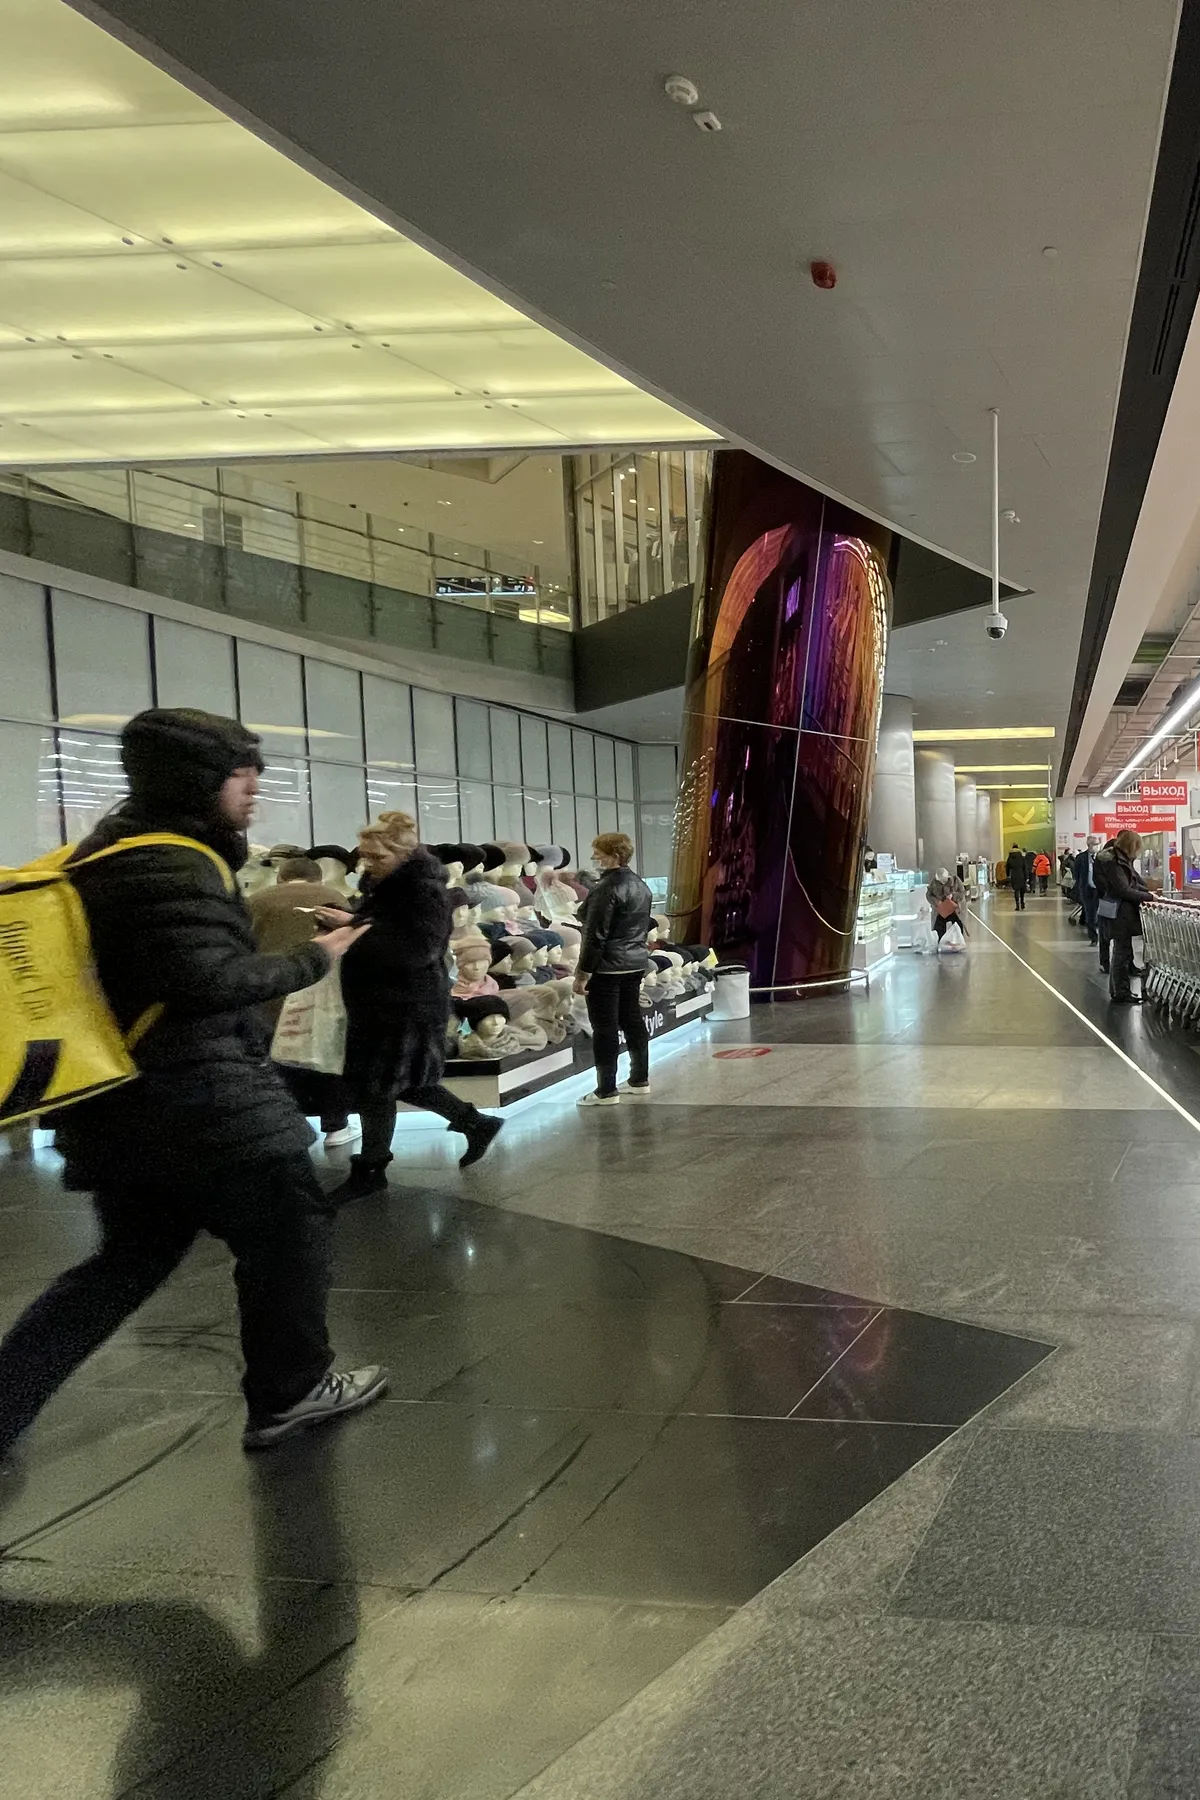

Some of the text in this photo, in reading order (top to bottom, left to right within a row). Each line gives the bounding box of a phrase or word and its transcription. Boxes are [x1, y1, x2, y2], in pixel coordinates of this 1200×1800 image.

[1143, 786, 1185, 797] ВЫХОД
[1117, 805, 1149, 814] ВЫХОД
[642, 1009, 664, 1037] tyle
